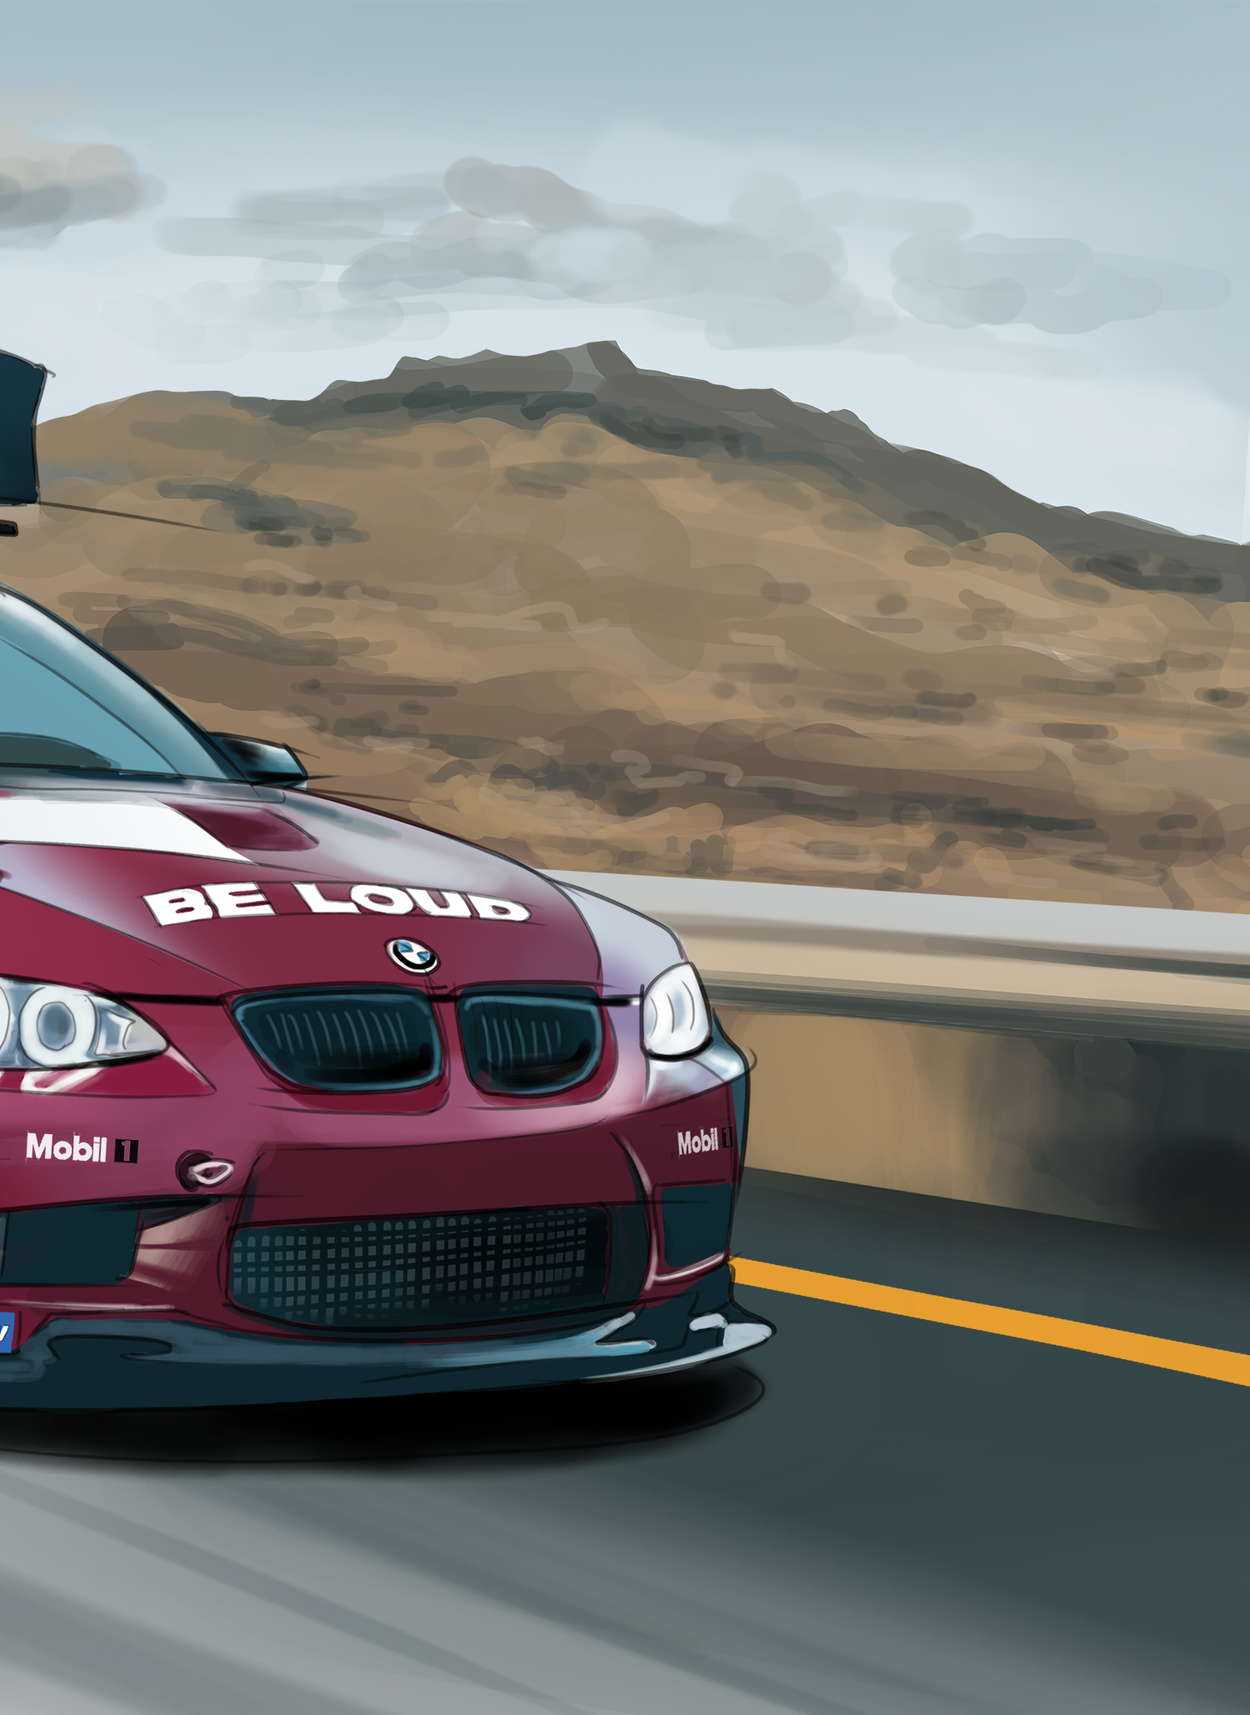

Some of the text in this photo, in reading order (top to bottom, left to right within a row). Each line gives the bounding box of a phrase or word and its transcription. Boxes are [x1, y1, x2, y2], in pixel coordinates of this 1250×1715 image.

[142, 882, 532, 926] BE LOUD
[26, 1132, 108, 1163] Mobil
[677, 1126, 719, 1156] Mobil
